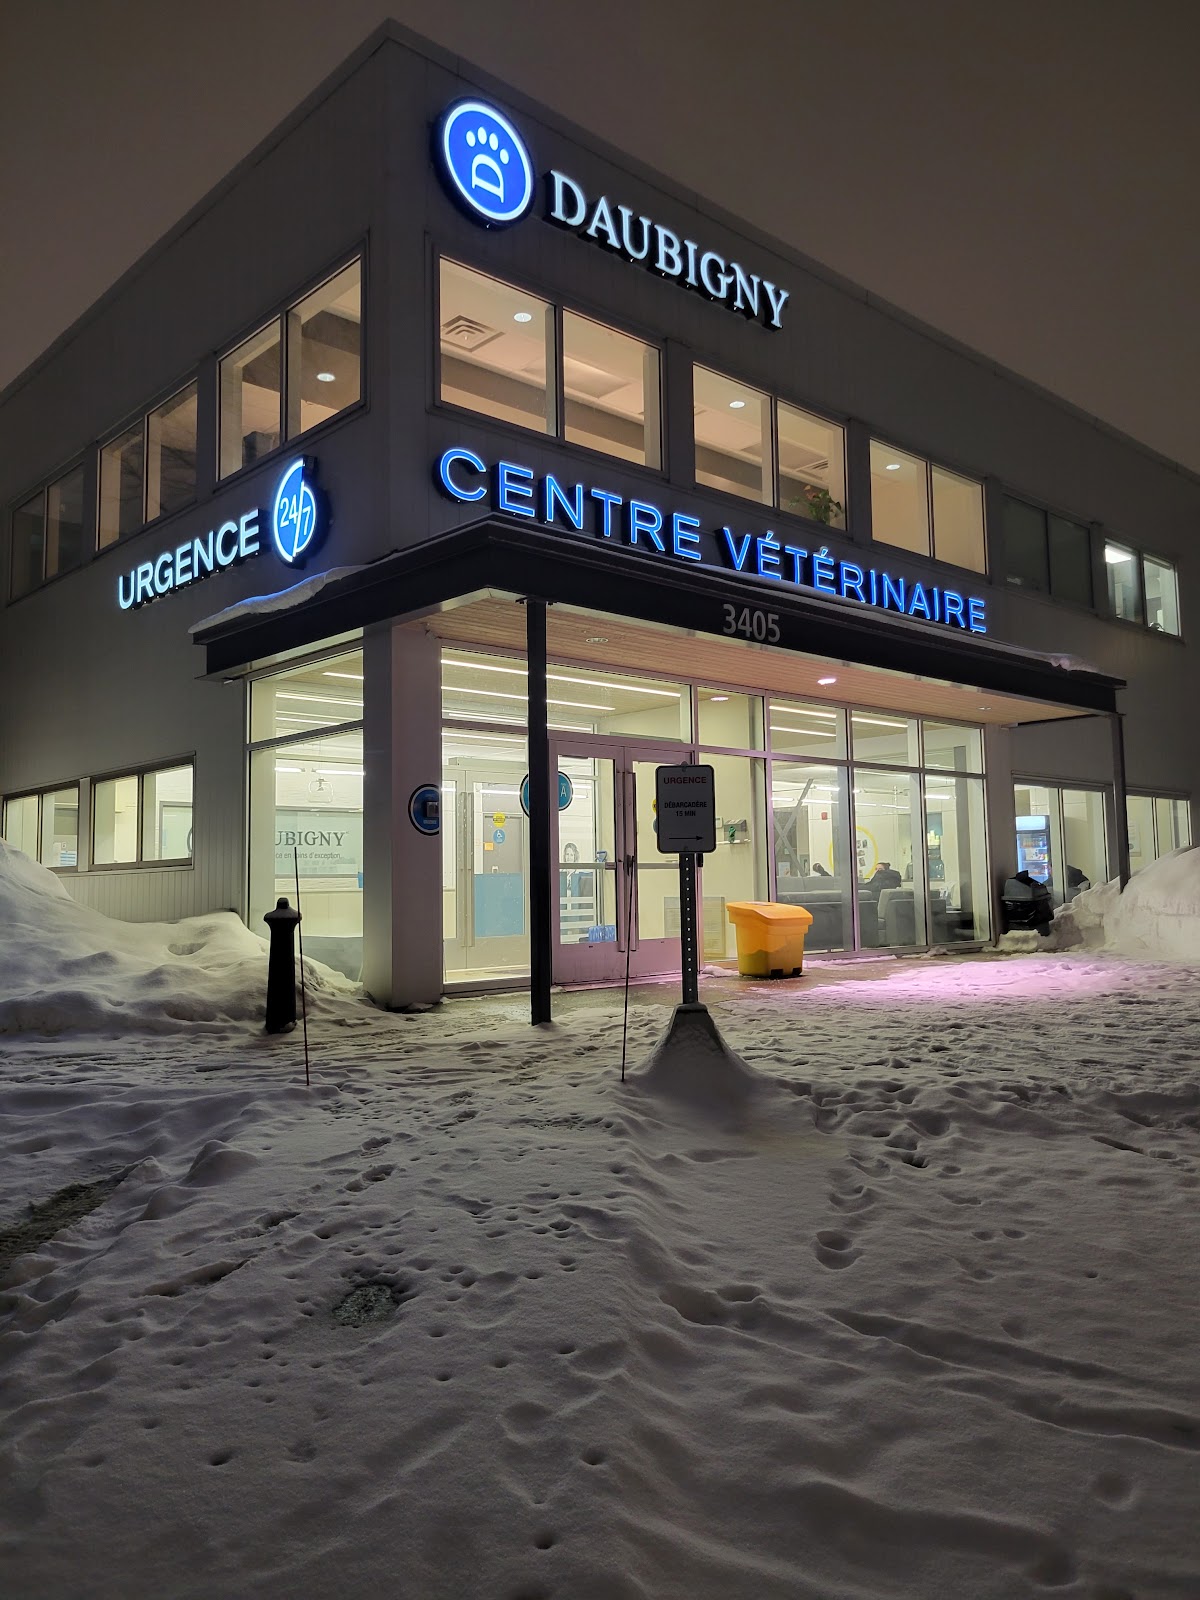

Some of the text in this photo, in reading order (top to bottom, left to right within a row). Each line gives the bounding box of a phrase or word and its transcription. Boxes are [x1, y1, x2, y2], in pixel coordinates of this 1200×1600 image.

[550, 169, 789, 328] DAUBIGNY
[118, 508, 260, 610] URGENCE
[440, 448, 987, 633] CENTRE VÉTÉRINAIRE
[722, 603, 781, 643] 3405
[663, 776, 707, 785] URGENCE
